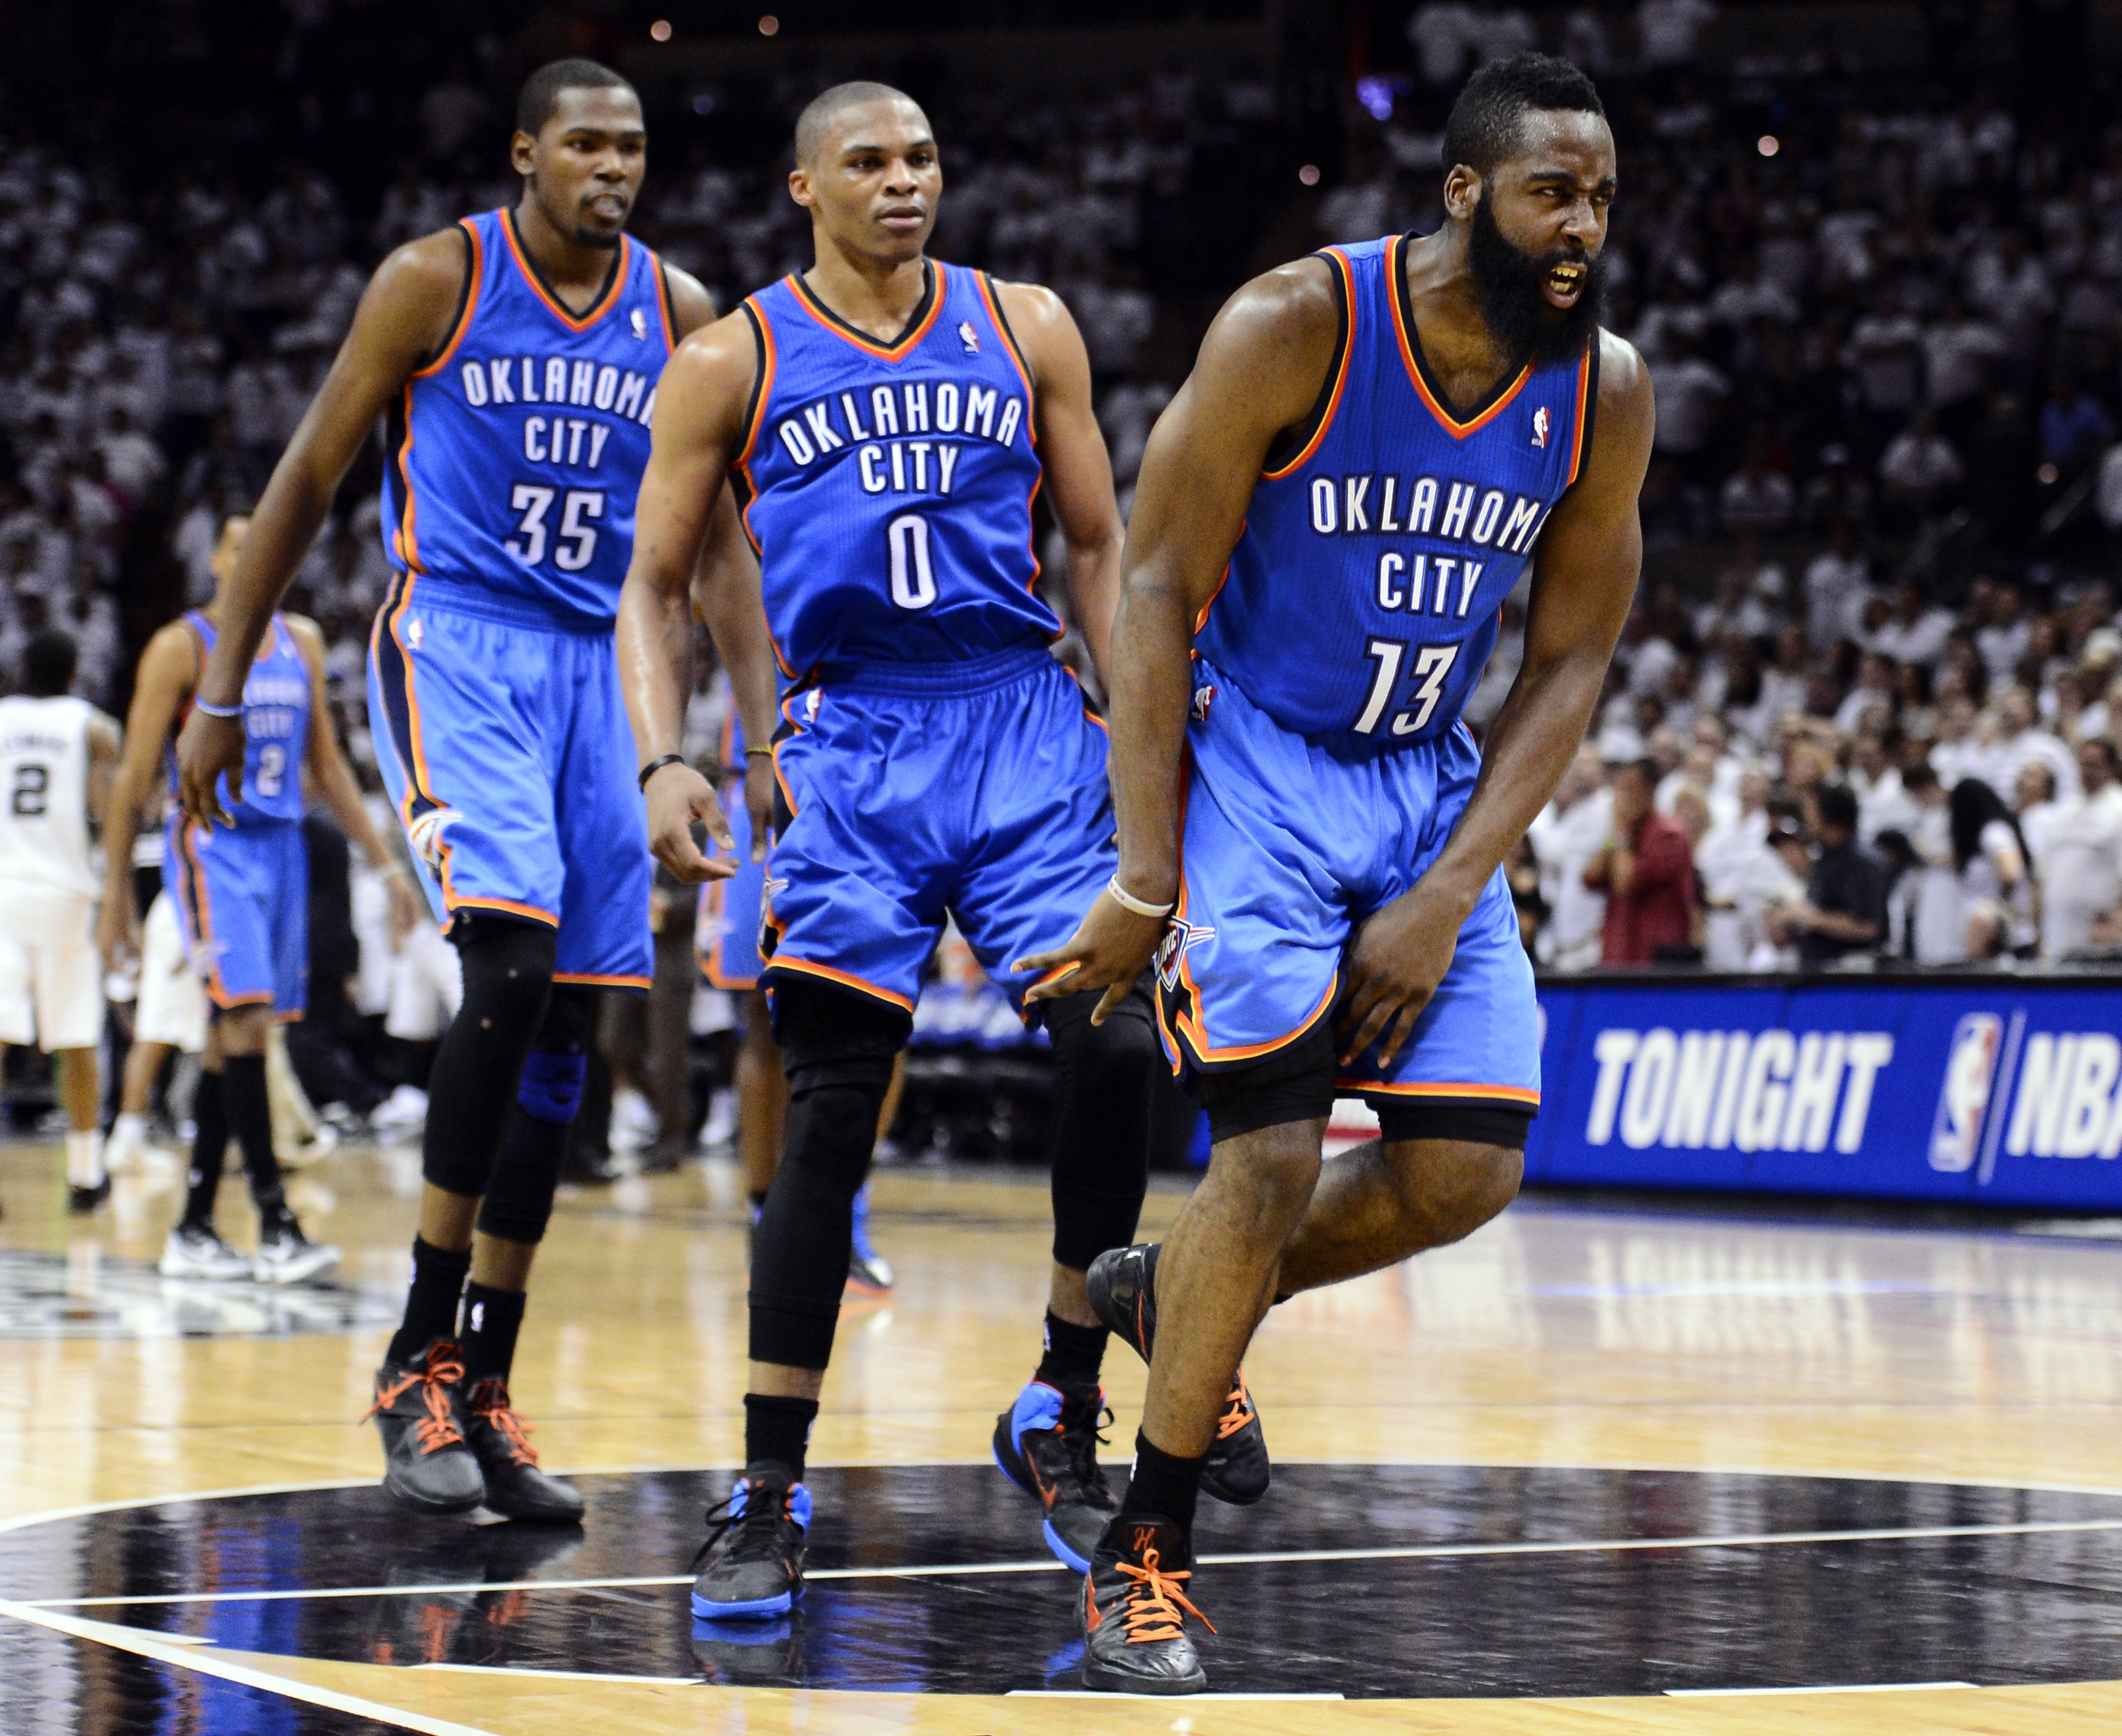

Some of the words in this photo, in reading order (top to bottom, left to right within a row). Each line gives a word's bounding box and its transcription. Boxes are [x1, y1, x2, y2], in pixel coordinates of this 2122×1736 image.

[524, 416, 611, 469] CITY
[779, 382, 1023, 466] OKLAHOMA
[859, 442, 959, 494] CITY
[503, 484, 604, 571] 35
[888, 513, 937, 610] 0
[1379, 552, 1482, 617] CITY
[1353, 640, 1459, 736] 13
[11, 765, 49, 815] 2
[256, 743, 286, 797] 2
[1586, 1027, 1894, 1155] TONIGHT
